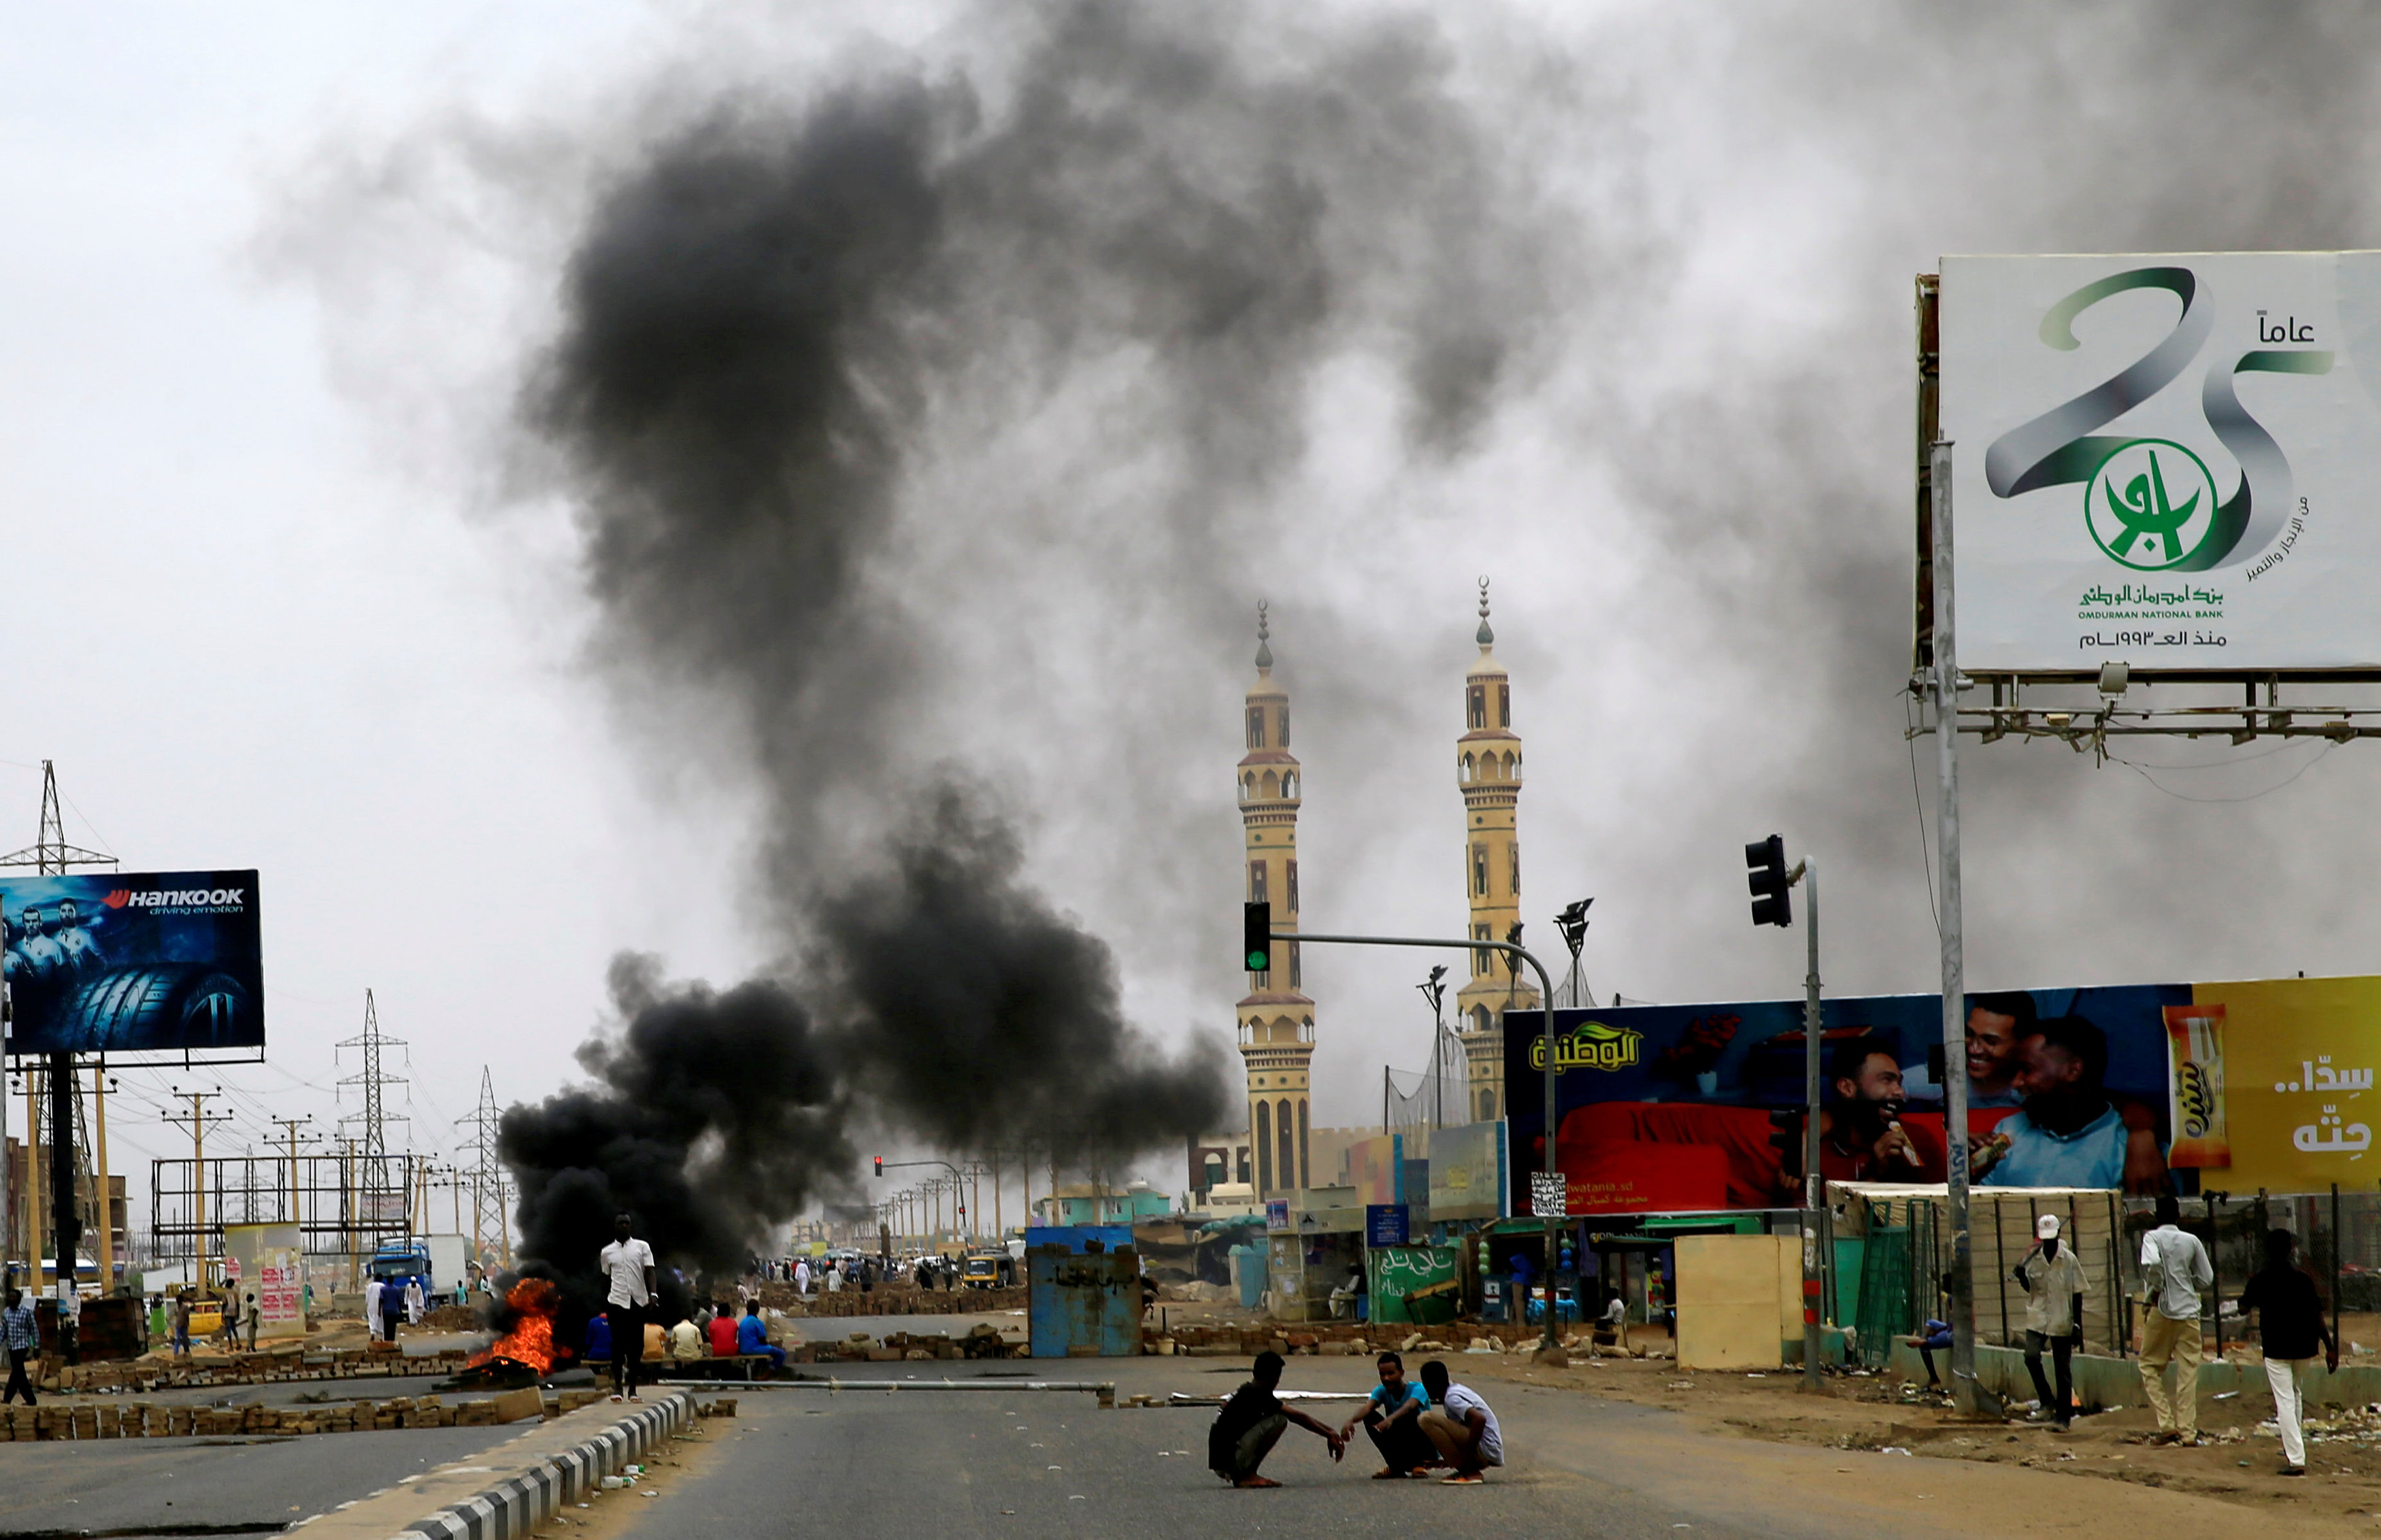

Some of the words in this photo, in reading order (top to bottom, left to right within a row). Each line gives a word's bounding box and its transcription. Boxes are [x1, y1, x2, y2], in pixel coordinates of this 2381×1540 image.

[2298, 497, 2310, 516] من
[2246, 552, 2284, 582] والتميز
[2193, 587, 2224, 605] بنك
[2078, 610, 2138, 619] OMDURMAN
[2142, 610, 2192, 619] NATIONAL
[2195, 610, 2224, 618] BANK
[2193, 631, 2227, 648] منذ
[150, 906, 190, 916] driving
[193, 905, 244, 914] emotion
[1532, 1033, 1637, 1073] الوطنية
